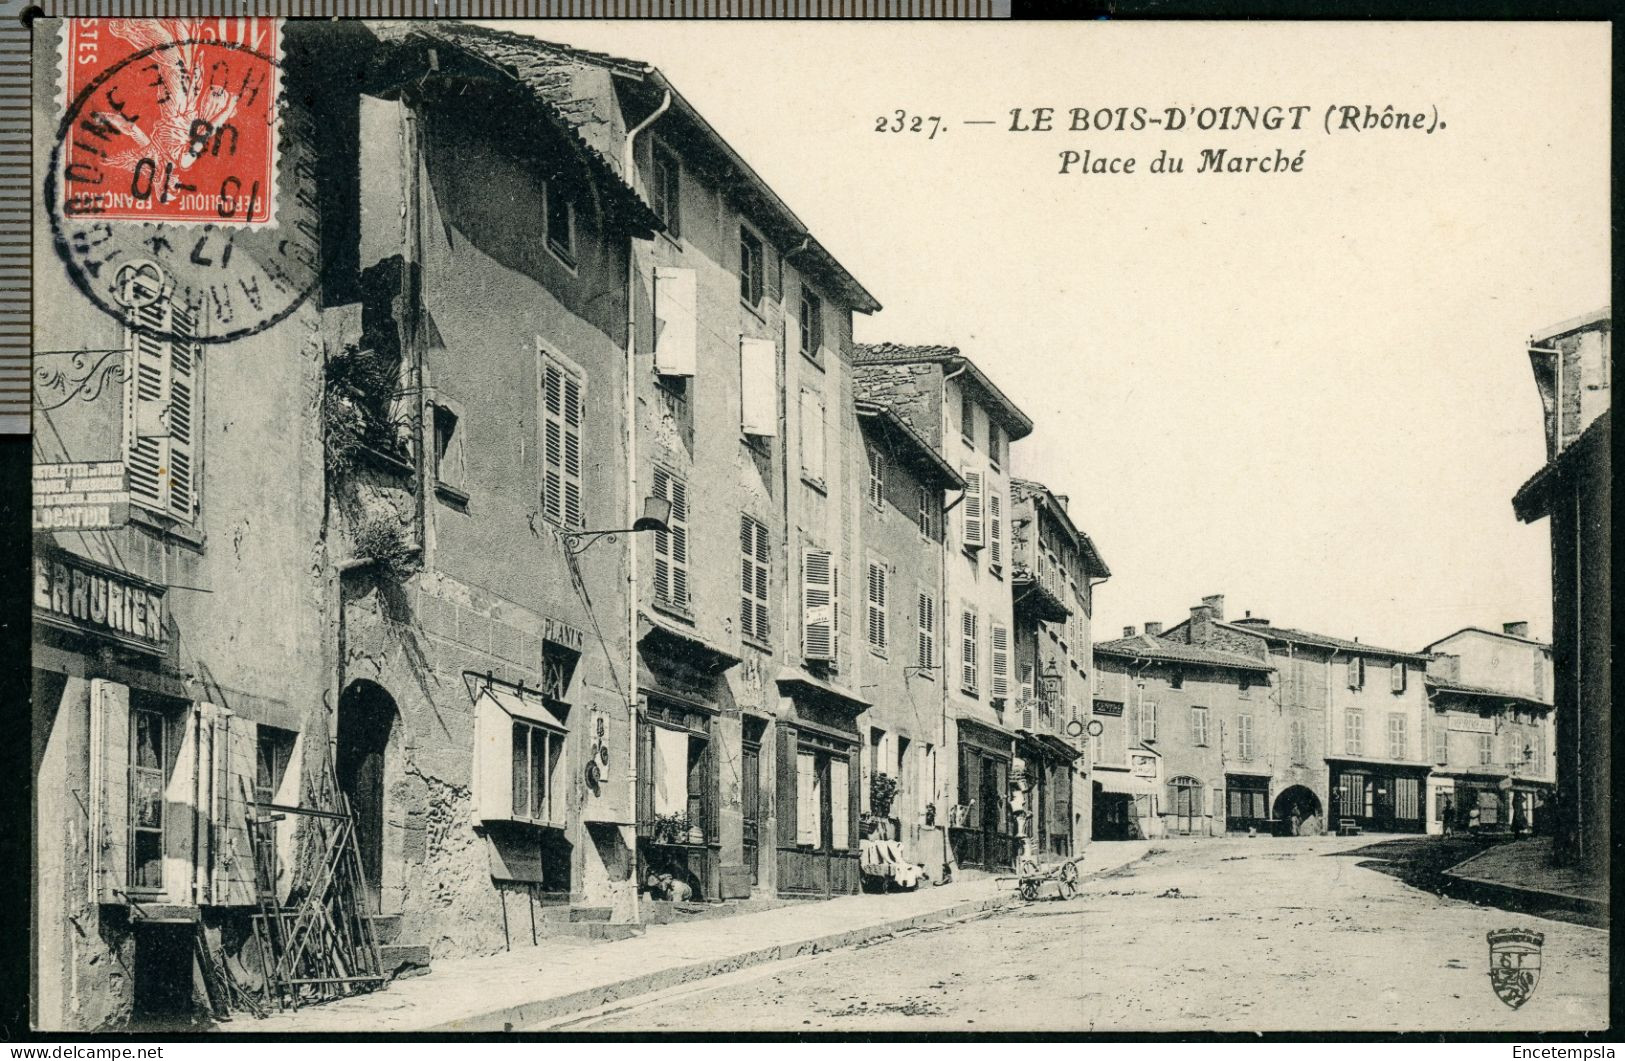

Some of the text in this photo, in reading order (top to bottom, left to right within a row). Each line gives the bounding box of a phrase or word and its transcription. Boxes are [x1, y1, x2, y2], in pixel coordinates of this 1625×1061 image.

[874, 109, 947, 140] 2327.
[1008, 107, 1055, 132] LE
[1068, 105, 1311, 132] BOIS-D'OINGT
[1324, 104, 1447, 135] (Rhône).
[1058, 148, 1306, 175] Place du Marché
[32, 506, 110, 529] LOCATION
